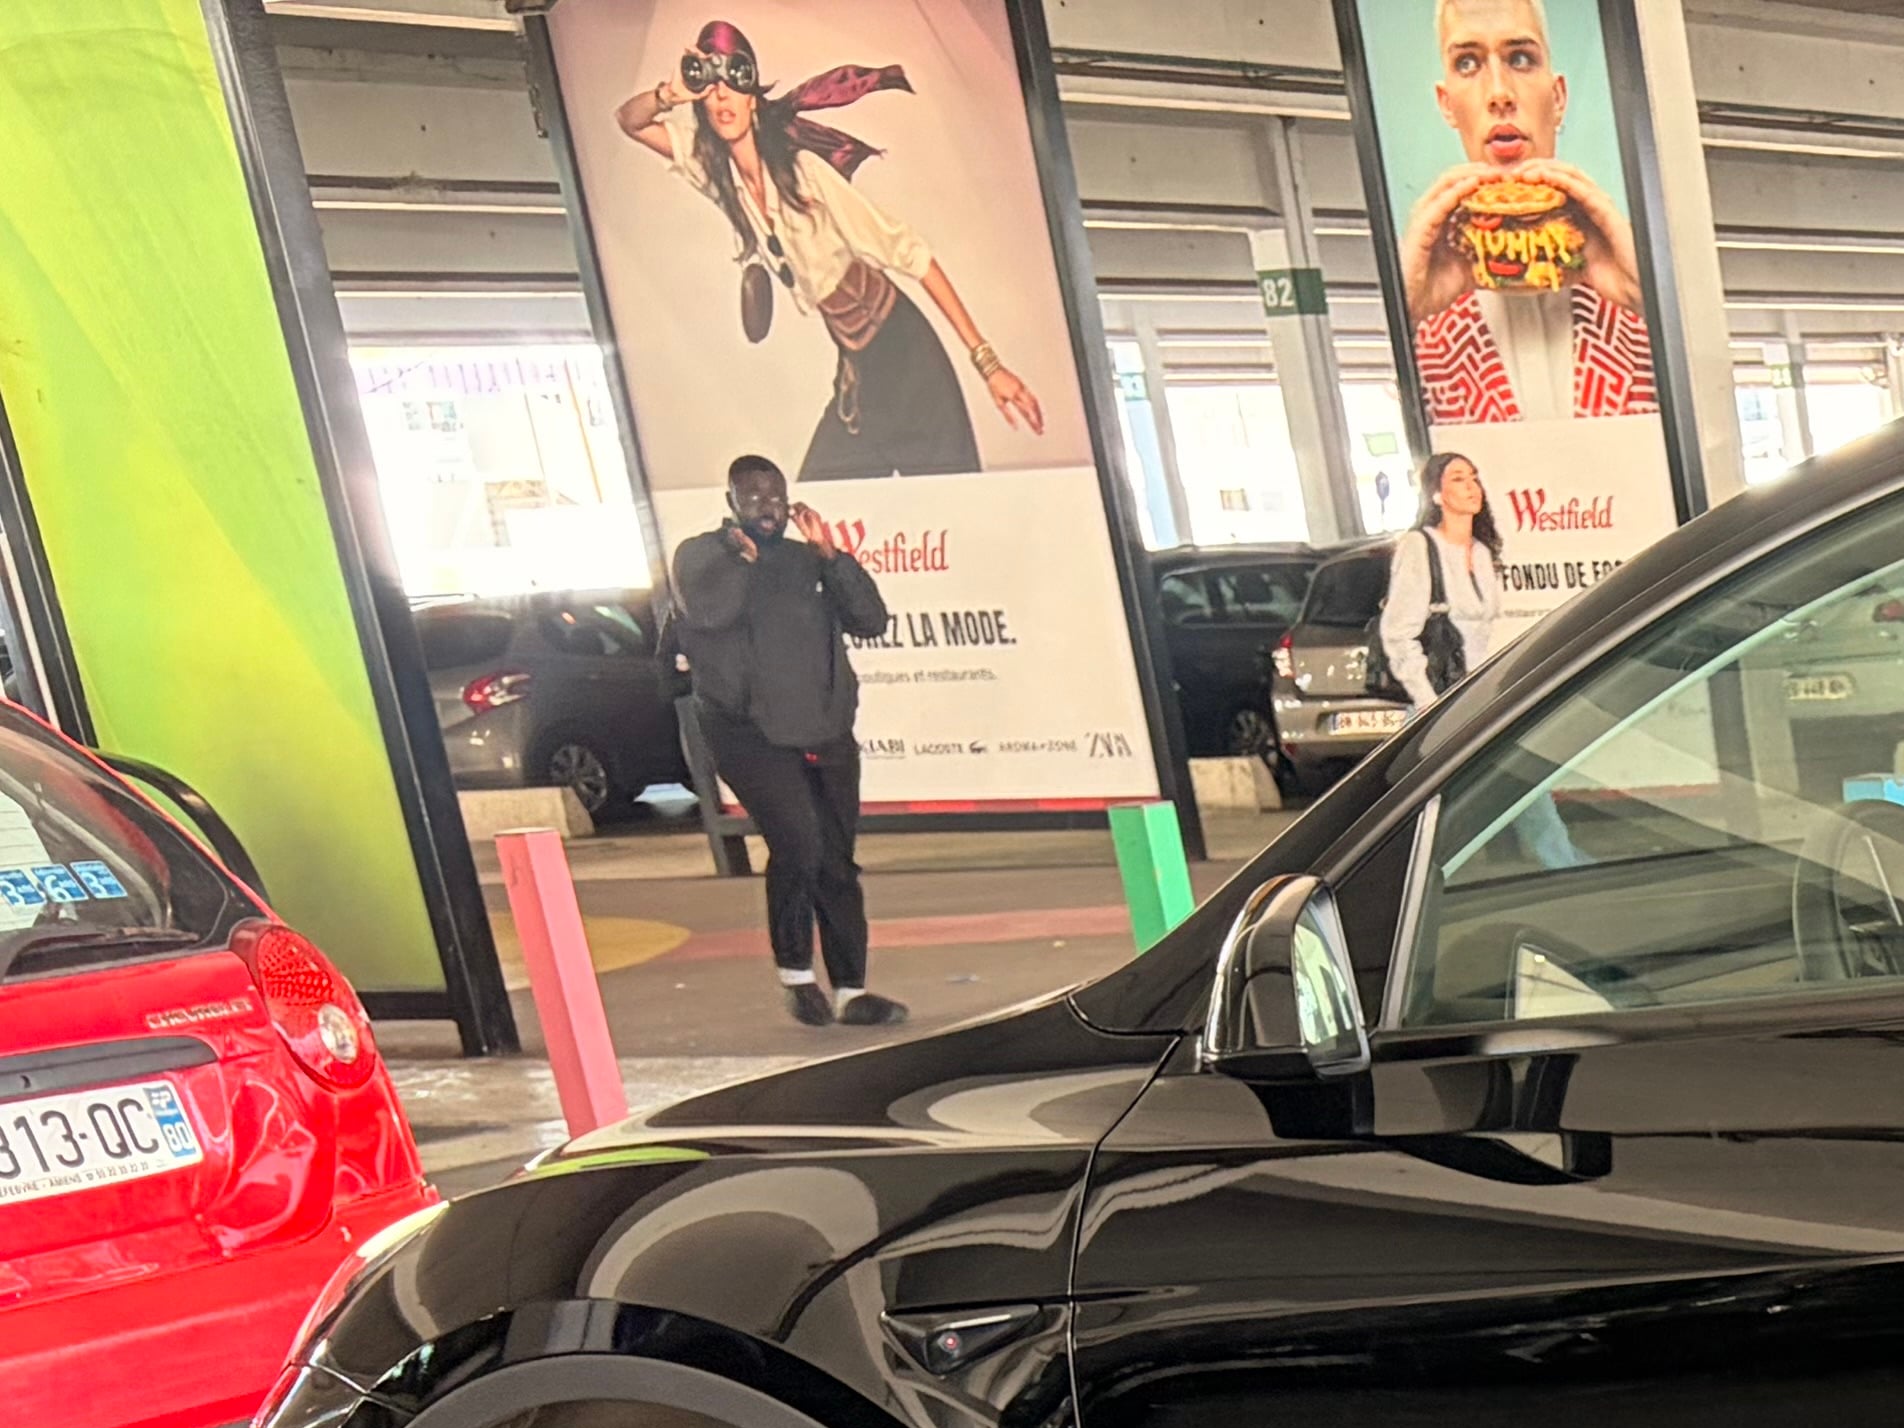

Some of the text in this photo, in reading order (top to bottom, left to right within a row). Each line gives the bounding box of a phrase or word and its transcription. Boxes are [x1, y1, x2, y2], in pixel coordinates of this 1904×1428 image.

[1463, 222, 1572, 266] YUMMY
[1262, 278, 1296, 307] 82
[1506, 487, 1615, 532] Westfield
[1503, 562, 1559, 592] FONDU
[1564, 561, 1589, 588] DE
[907, 612, 938, 648] LA
[940, 609, 1017, 646] MODE.
[162, 1121, 197, 1153] 80
